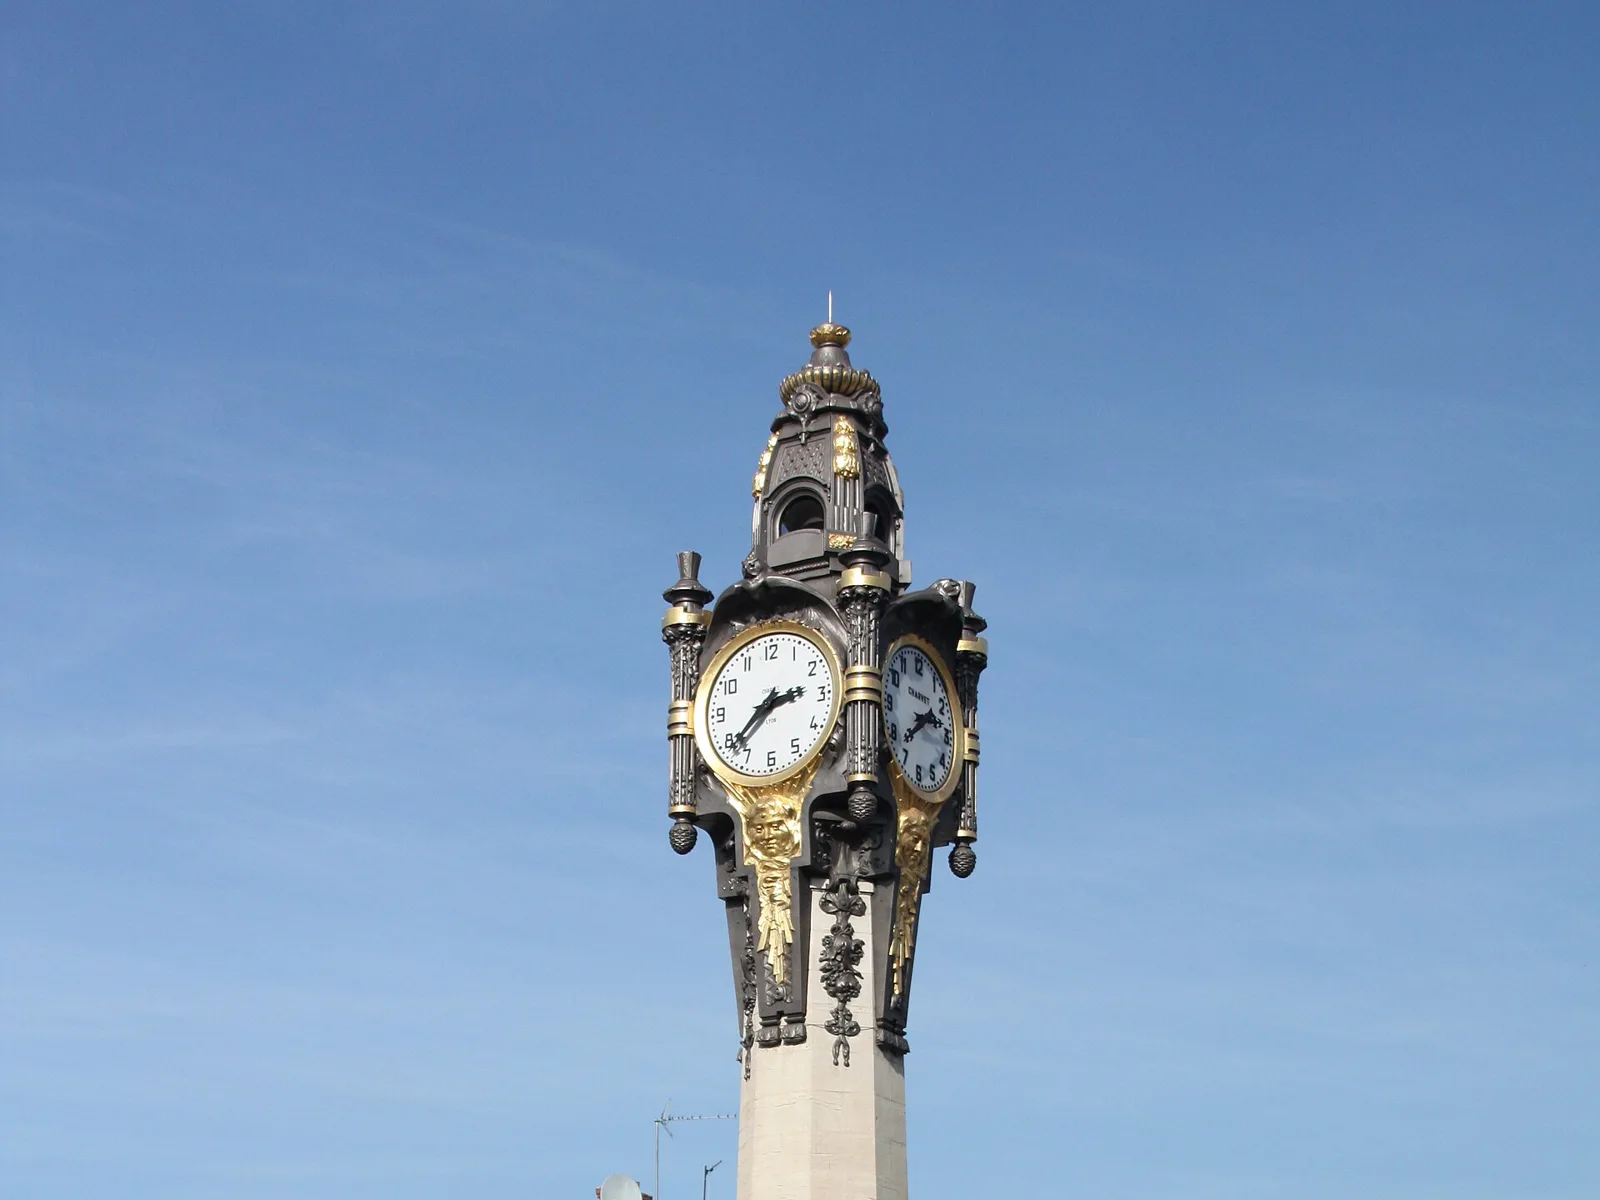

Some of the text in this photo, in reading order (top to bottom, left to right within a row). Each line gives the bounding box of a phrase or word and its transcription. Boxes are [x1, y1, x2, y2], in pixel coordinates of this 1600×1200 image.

[764, 643, 779, 662] 12
[792, 645, 797, 662] 1
[743, 655, 752, 673] 11
[807, 660, 818, 678] 2
[900, 655, 907, 676] 11
[723, 678, 738, 696] 10
[816, 685, 827, 703] 3
[716, 706, 726, 724] 9
[938, 697, 945, 717] 2
[809, 714, 820, 731] 4
[890, 722, 898, 742] 8
[943, 726, 950, 746] 3
[724, 733, 736, 750] 8
[790, 737, 801, 755] 5
[742, 748, 752, 765] 7
[766, 750, 777, 768] 6
[902, 747, 909, 766] 7
[938, 752, 946, 770] 4
[915, 763, 923, 783] 6
[929, 763, 937, 782] 5
